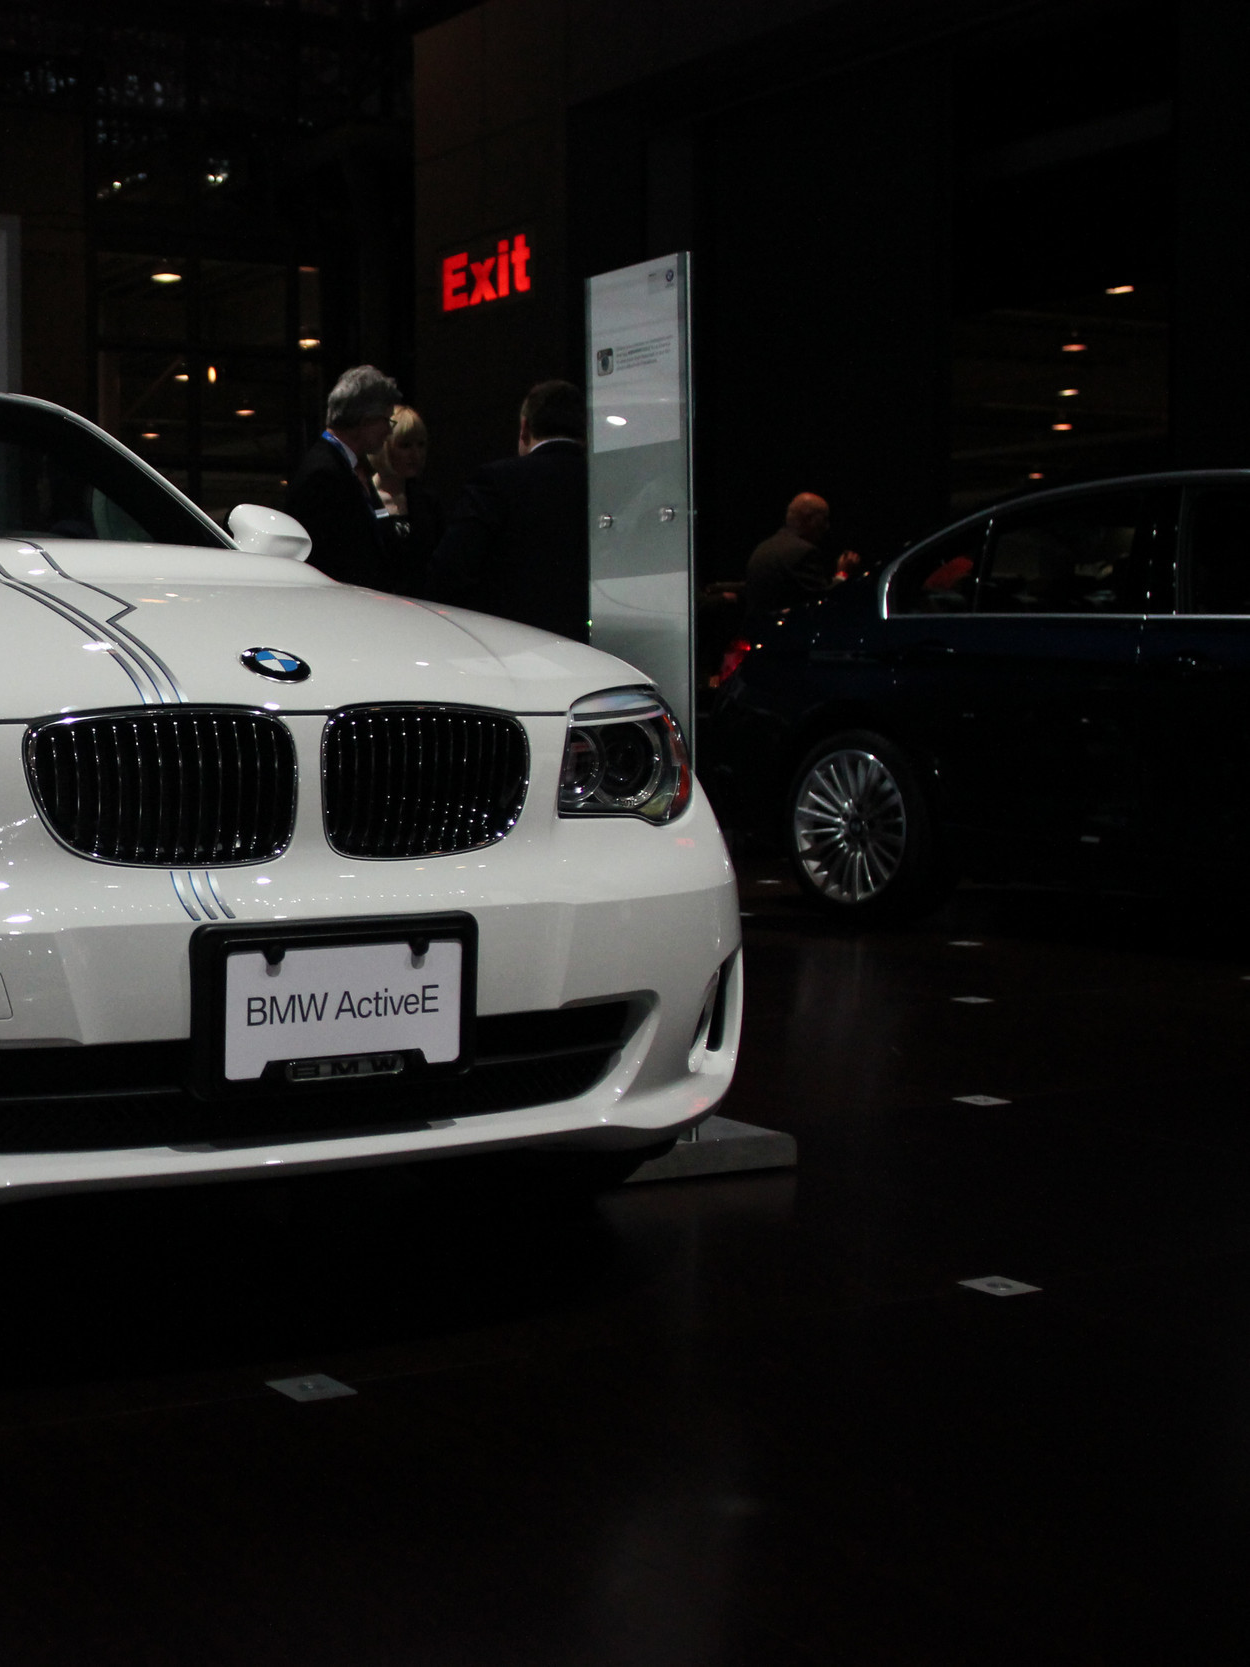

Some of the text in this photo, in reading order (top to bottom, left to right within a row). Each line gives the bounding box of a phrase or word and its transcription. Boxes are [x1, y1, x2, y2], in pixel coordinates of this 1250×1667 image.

[442, 232, 532, 313] Exit
[246, 984, 440, 1027] BMW ActiveE
[292, 1055, 398, 1079] BMW
